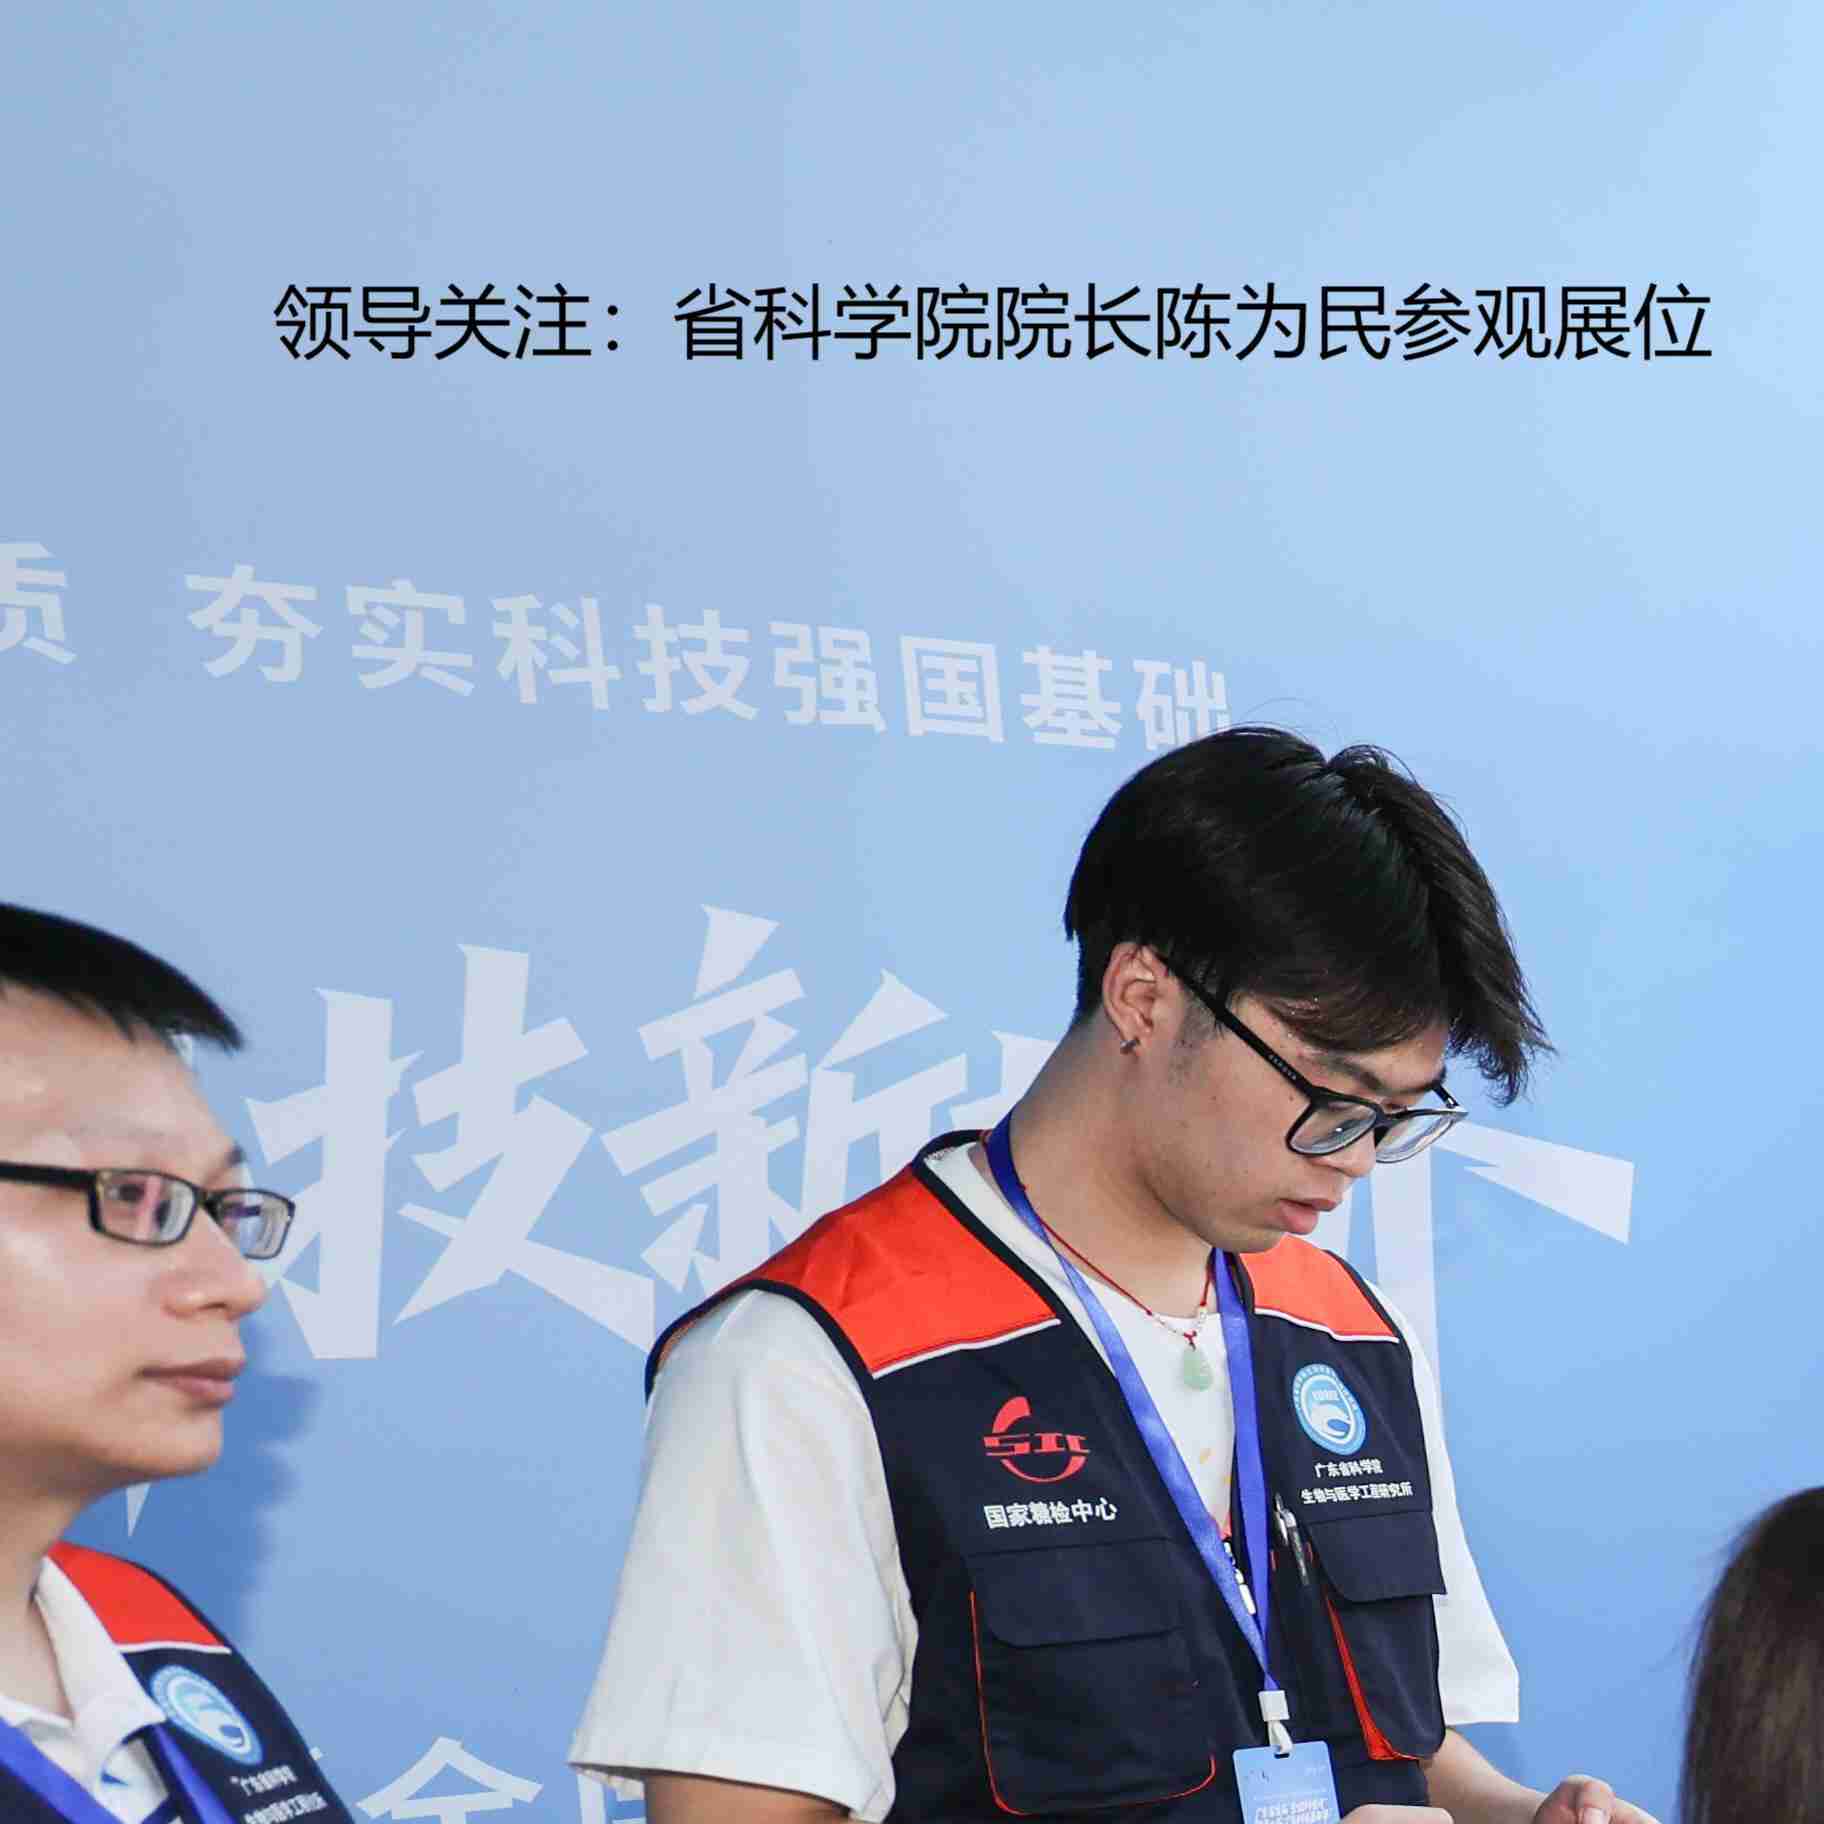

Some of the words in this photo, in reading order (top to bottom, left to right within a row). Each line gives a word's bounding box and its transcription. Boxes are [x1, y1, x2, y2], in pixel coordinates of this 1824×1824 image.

[184, 562, 1232, 751] 夯实科技强国基础
